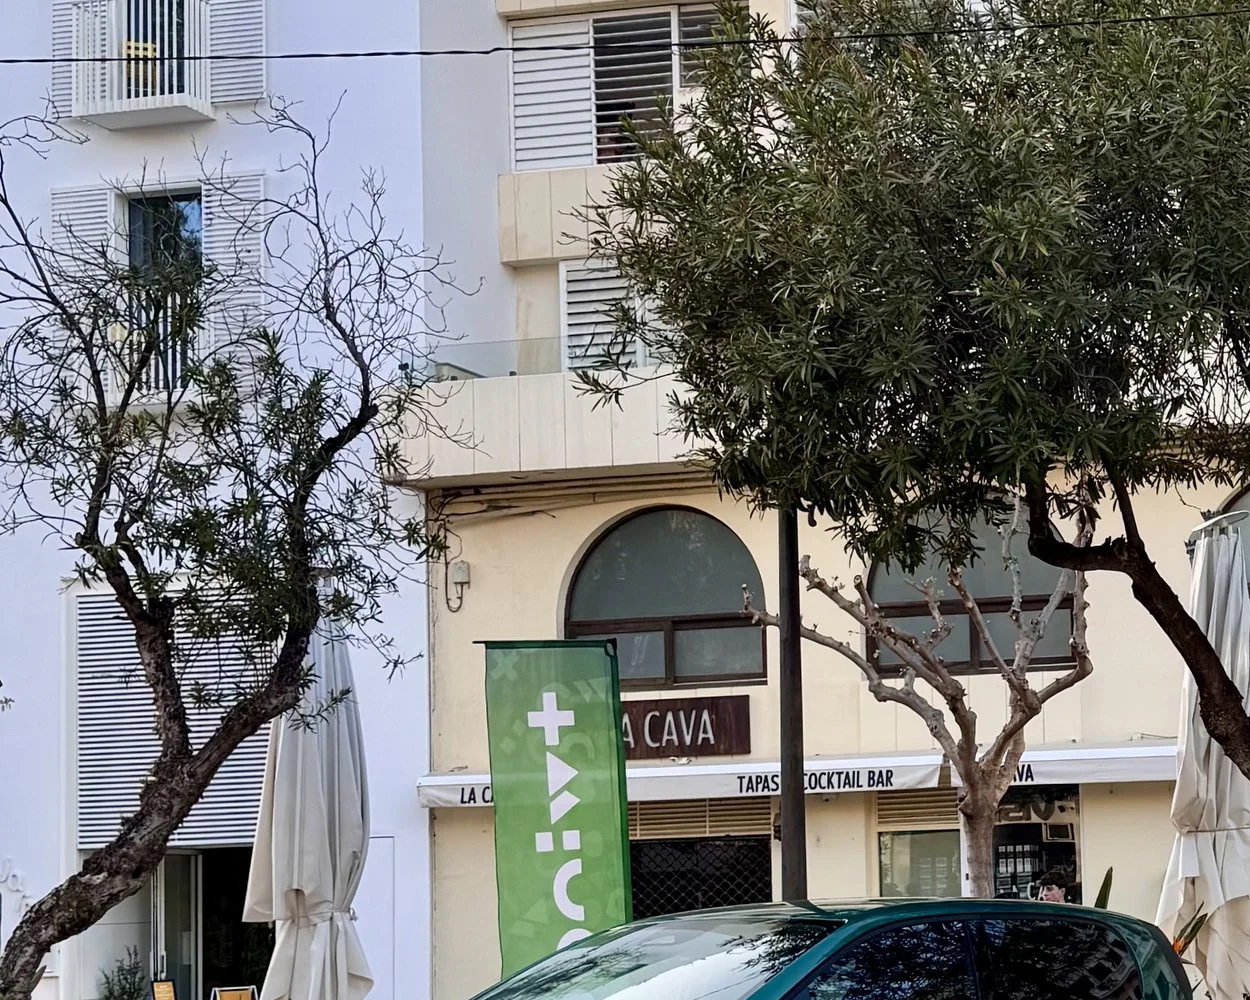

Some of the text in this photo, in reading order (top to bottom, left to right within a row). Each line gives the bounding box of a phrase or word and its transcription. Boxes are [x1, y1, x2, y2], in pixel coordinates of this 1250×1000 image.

[644, 708, 715, 747] CAVA
[737, 774, 780, 794] TAPAS
[867, 769, 894, 788] BAR
[460, 787, 477, 804] LA
